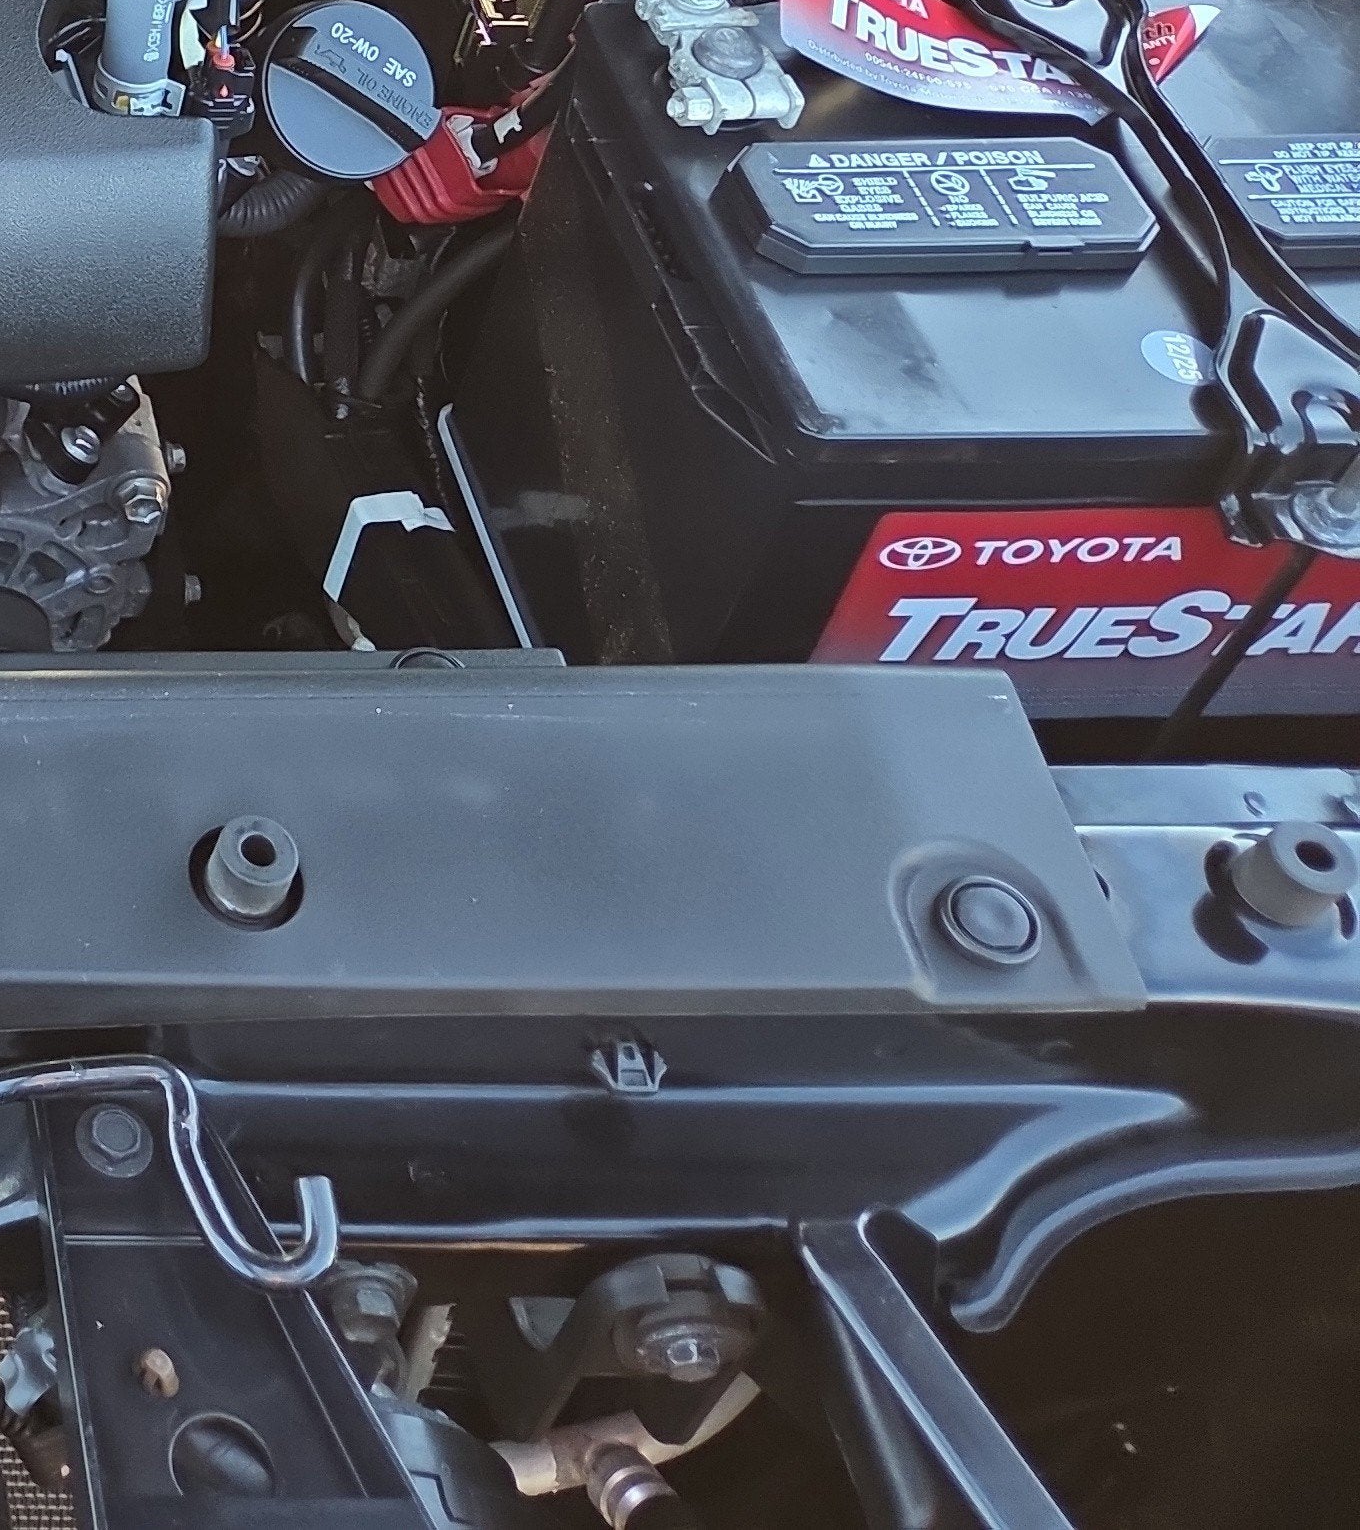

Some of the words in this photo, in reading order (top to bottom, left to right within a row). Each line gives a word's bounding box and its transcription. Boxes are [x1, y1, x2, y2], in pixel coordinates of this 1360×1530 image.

[331, 22, 380, 62] 0W-20
[356, 68, 378, 91] OIL
[382, 57, 417, 88] SAE
[377, 84, 433, 130] ENGINE
[830, 152, 931, 167] DANGER
[936, 152, 947, 165] /
[951, 150, 1047, 165] POISON
[1281, 164, 1324, 174] FLUSH
[1291, 174, 1323, 184] WITH
[851, 177, 898, 186] SHIELD
[856, 186, 892, 195] EYES
[834, 194, 904, 204] EXPLOSIVE
[1161, 334, 1203, 381] 12/25
[975, 535, 1182, 564] TOYOTA
